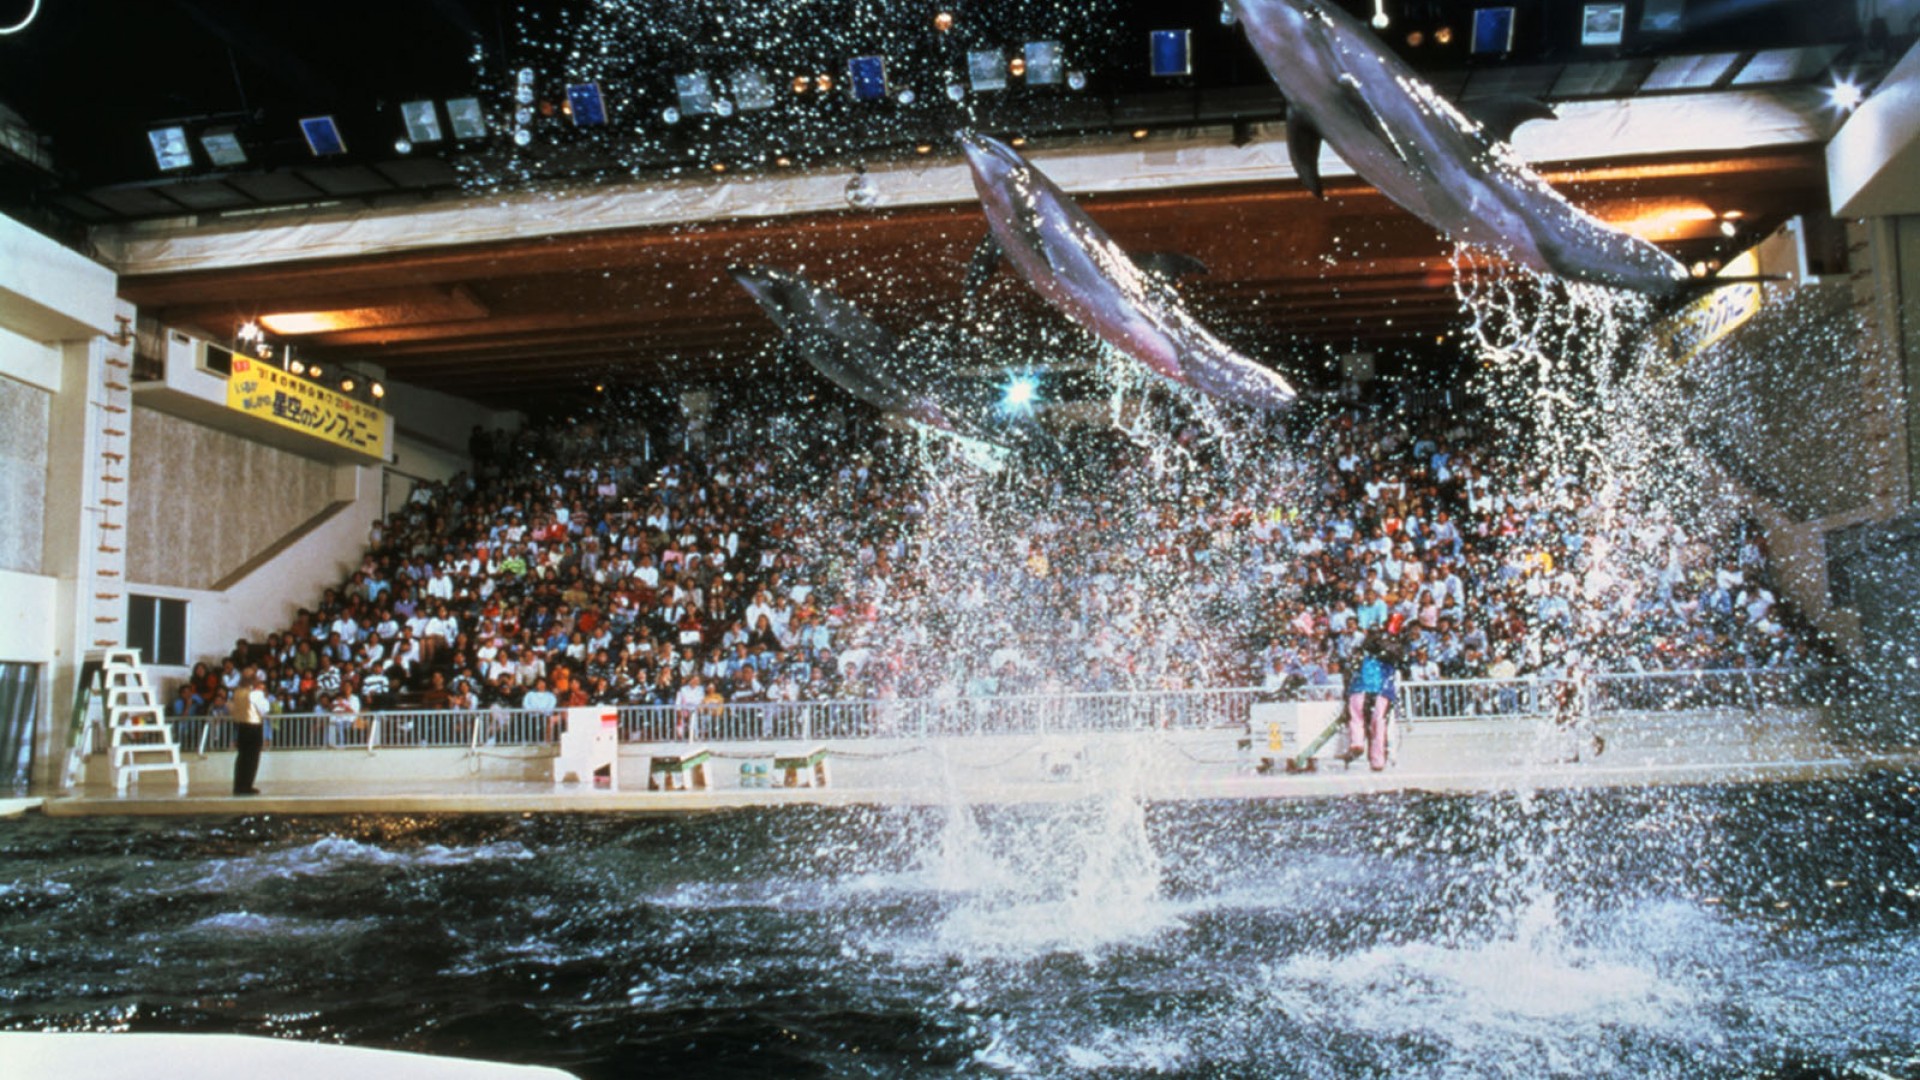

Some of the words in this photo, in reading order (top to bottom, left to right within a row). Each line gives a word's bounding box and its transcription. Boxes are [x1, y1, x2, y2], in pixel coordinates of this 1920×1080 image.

[273, 390, 377, 447] 星空のシンフォニー
